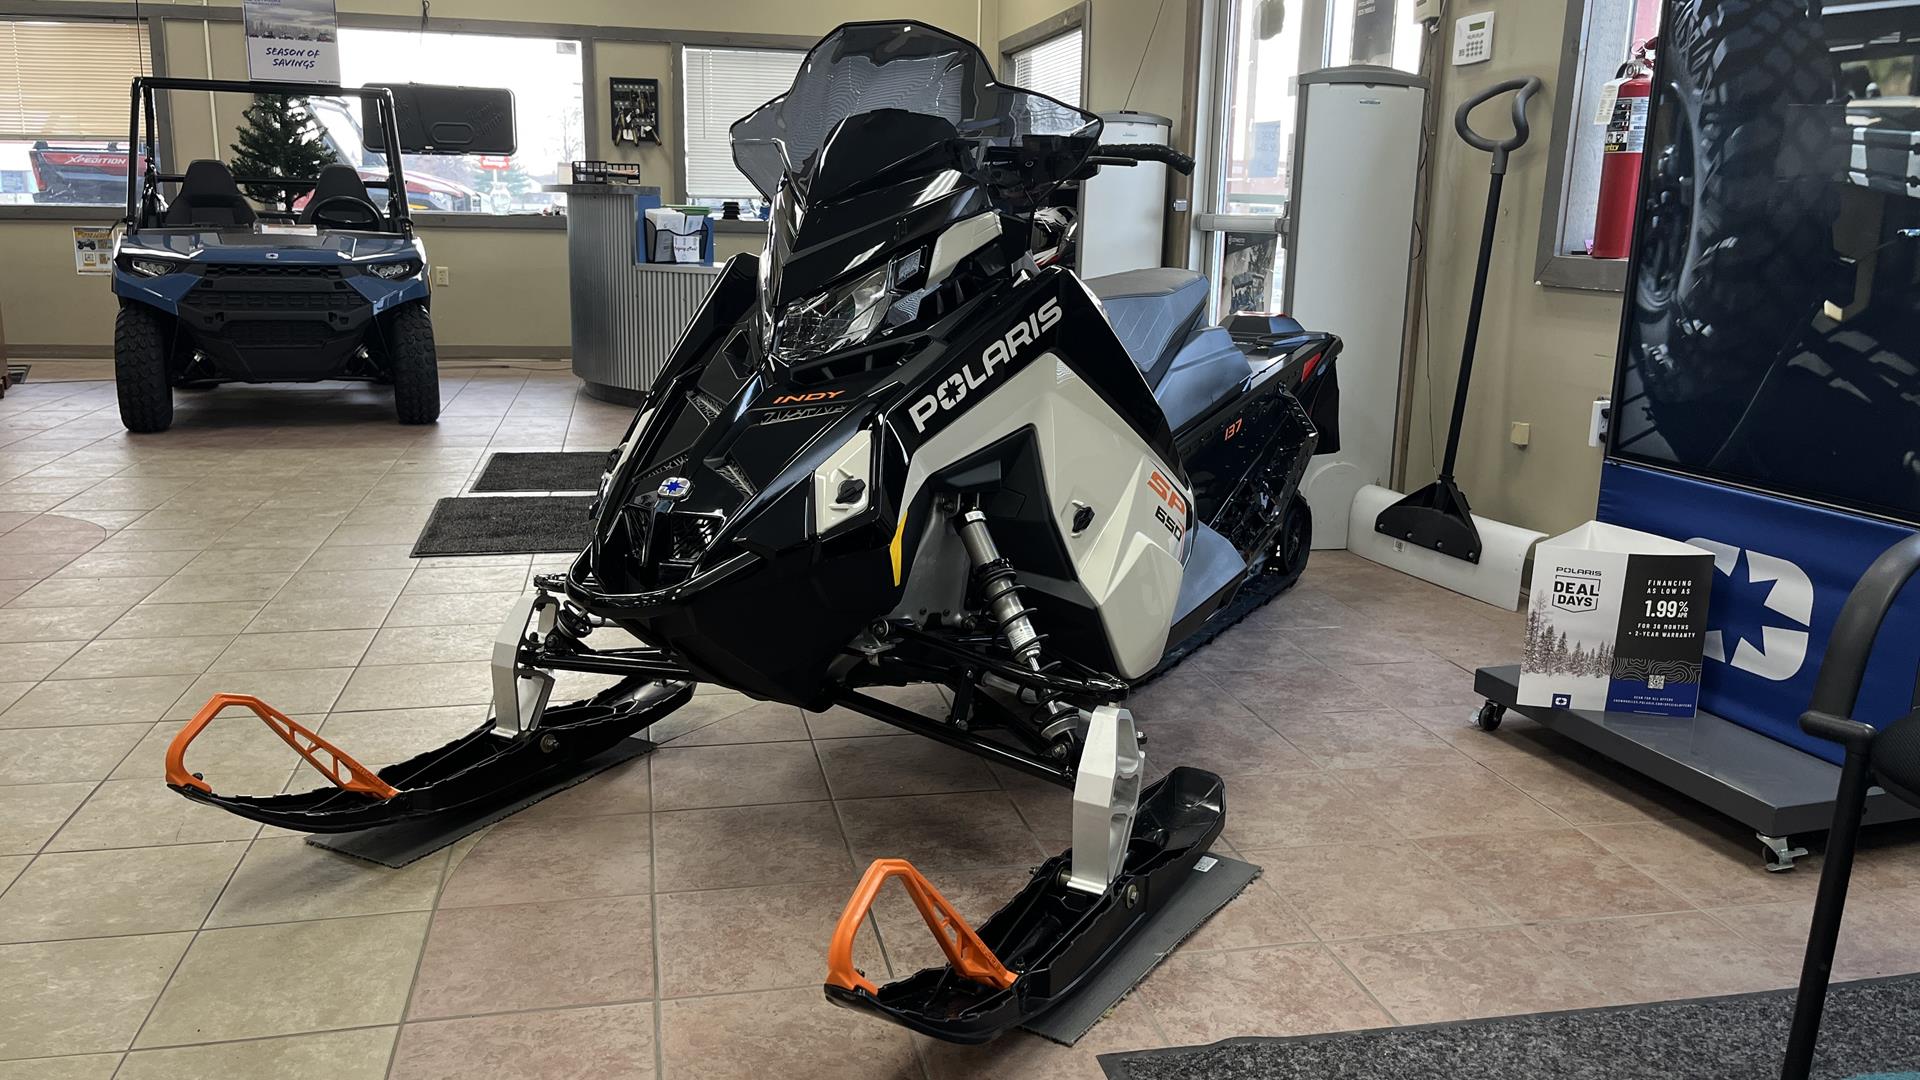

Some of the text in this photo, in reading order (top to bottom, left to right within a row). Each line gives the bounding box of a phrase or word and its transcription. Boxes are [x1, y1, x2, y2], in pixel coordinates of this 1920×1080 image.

[265, 47, 321, 59] SEASON OF
[271, 58, 316, 70] SAVINGS
[63, 154, 128, 165] XPEDITION
[907, 295, 1063, 434] POLARIS
[772, 390, 847, 405] INDY
[1223, 417, 1243, 441] 137
[1146, 470, 1186, 516] SP
[1154, 505, 1183, 543] 650
[1555, 566, 1602, 577] POLARIS
[1553, 580, 1600, 597] DEAL
[1557, 594, 1593, 607] DAYS
